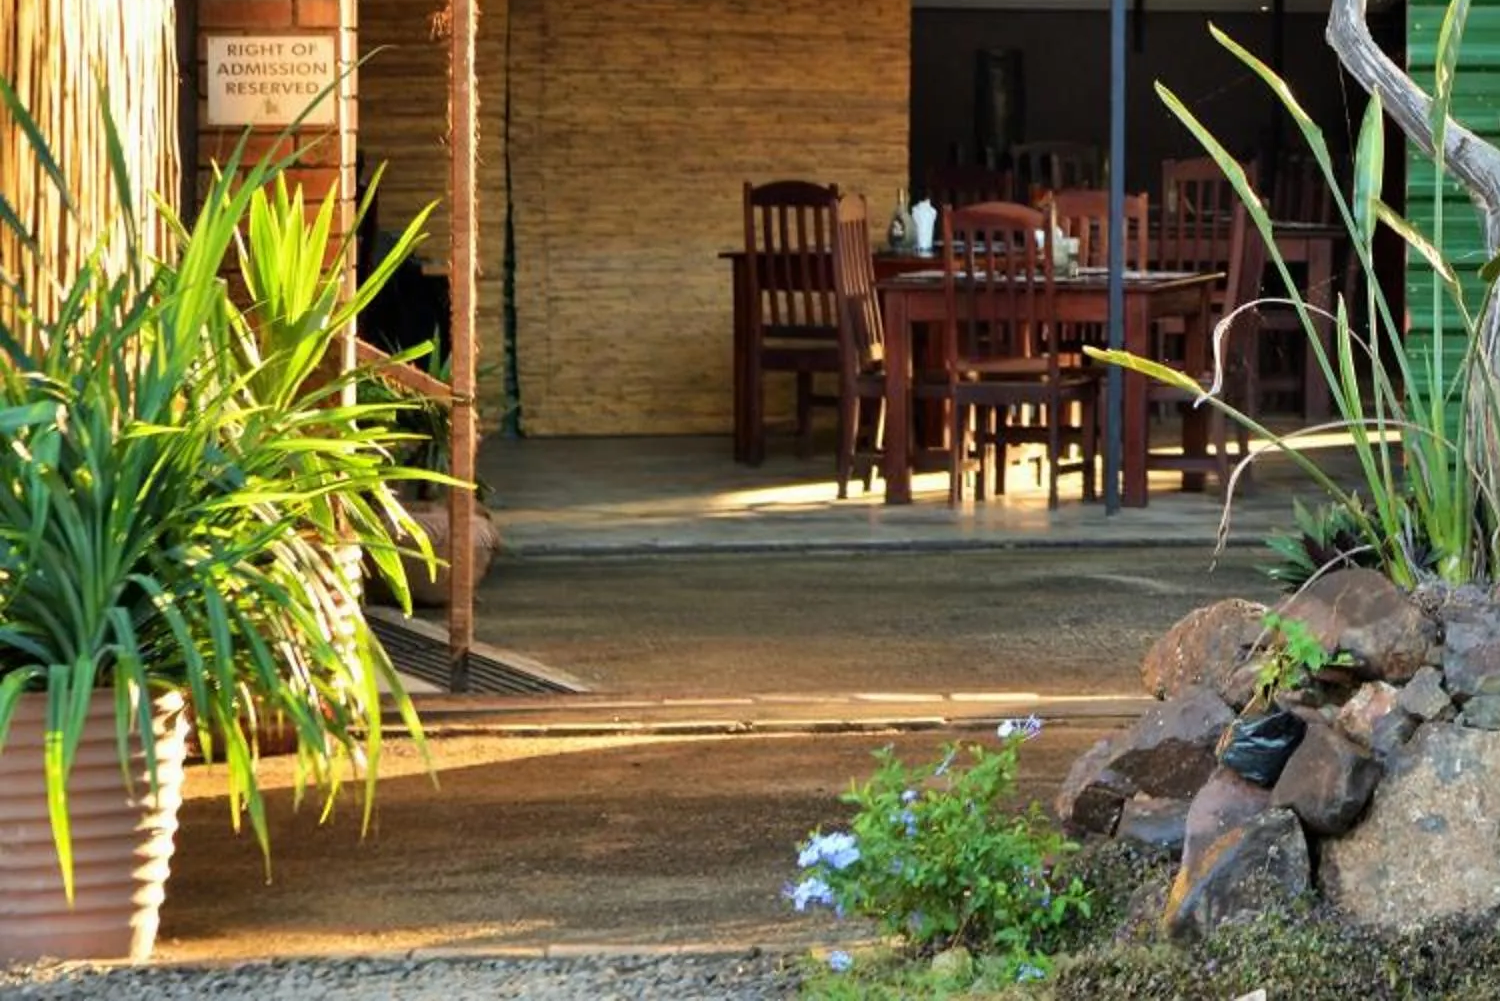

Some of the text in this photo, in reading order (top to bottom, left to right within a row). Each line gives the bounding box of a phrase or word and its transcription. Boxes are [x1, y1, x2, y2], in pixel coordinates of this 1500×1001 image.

[227, 43, 316, 57] RIGHT OF
[217, 62, 328, 76] ADMISSION
[225, 82, 320, 96] RESERVED
